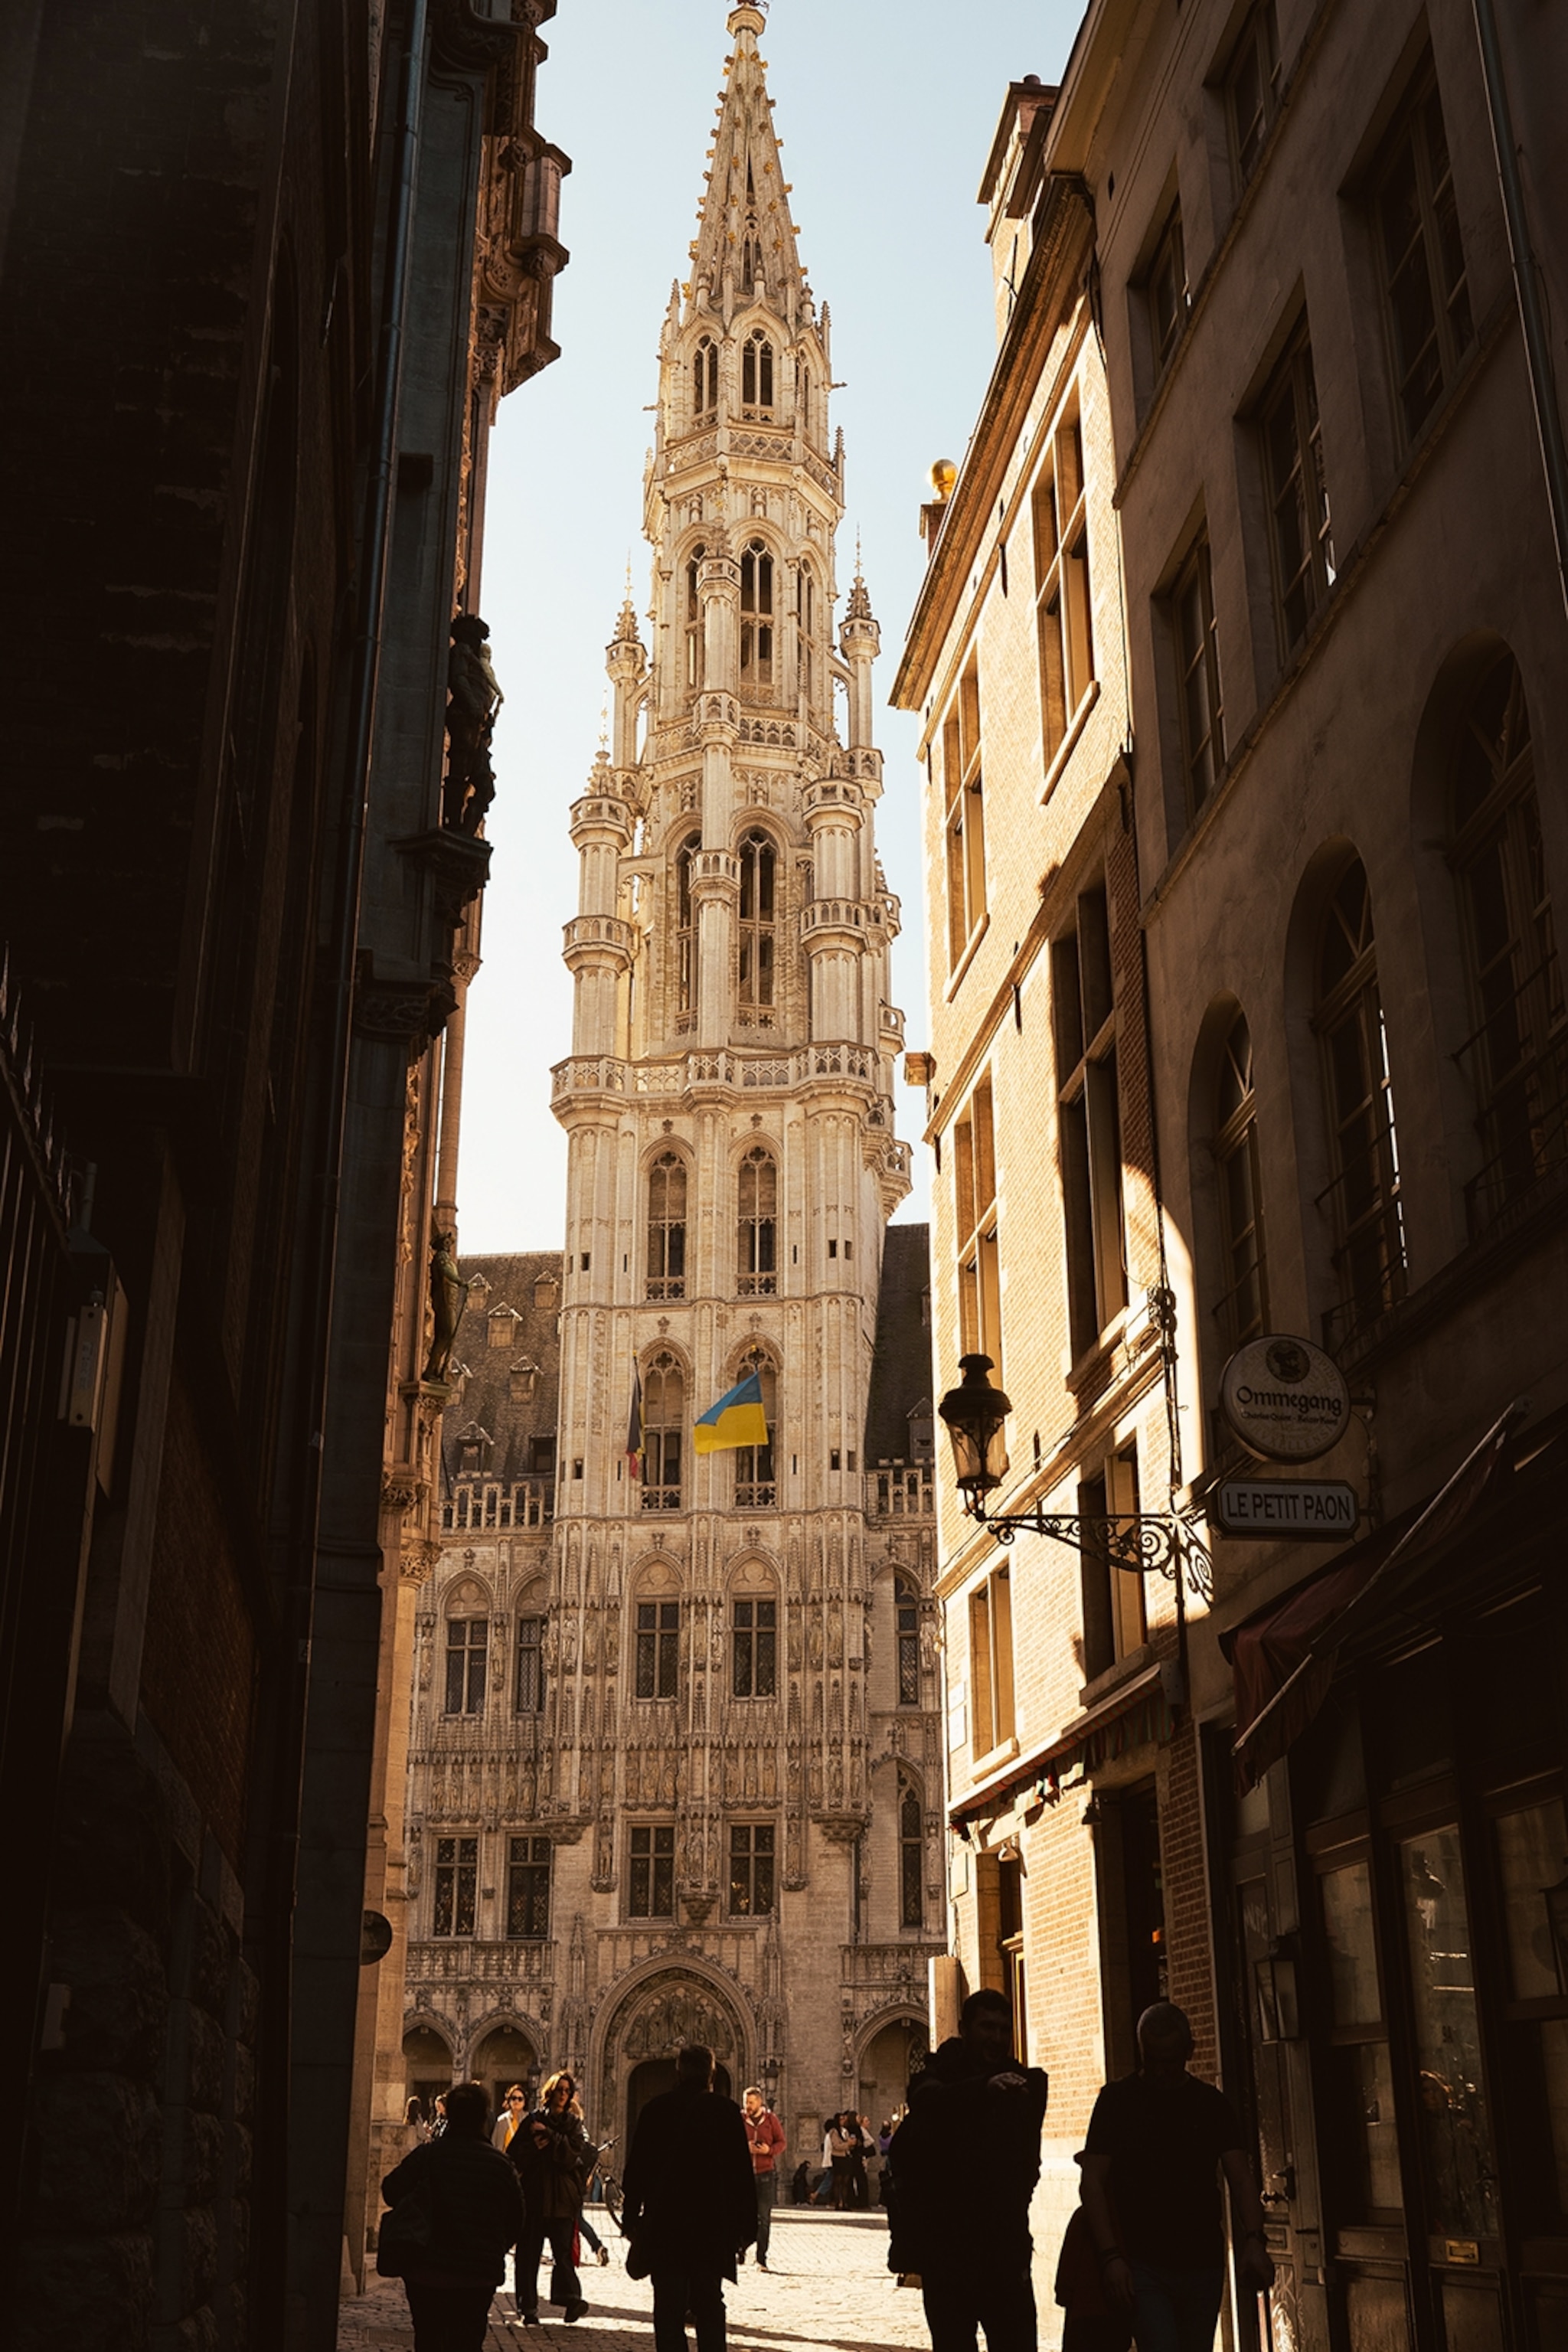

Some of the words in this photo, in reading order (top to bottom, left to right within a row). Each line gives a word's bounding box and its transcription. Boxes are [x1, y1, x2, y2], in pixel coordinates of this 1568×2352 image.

[1236, 1386, 1341, 1416] Ommegang
[1227, 1492, 1249, 1517] LE
[1253, 1494, 1299, 1519] PETIT
[1304, 1495, 1351, 1521] PAON
